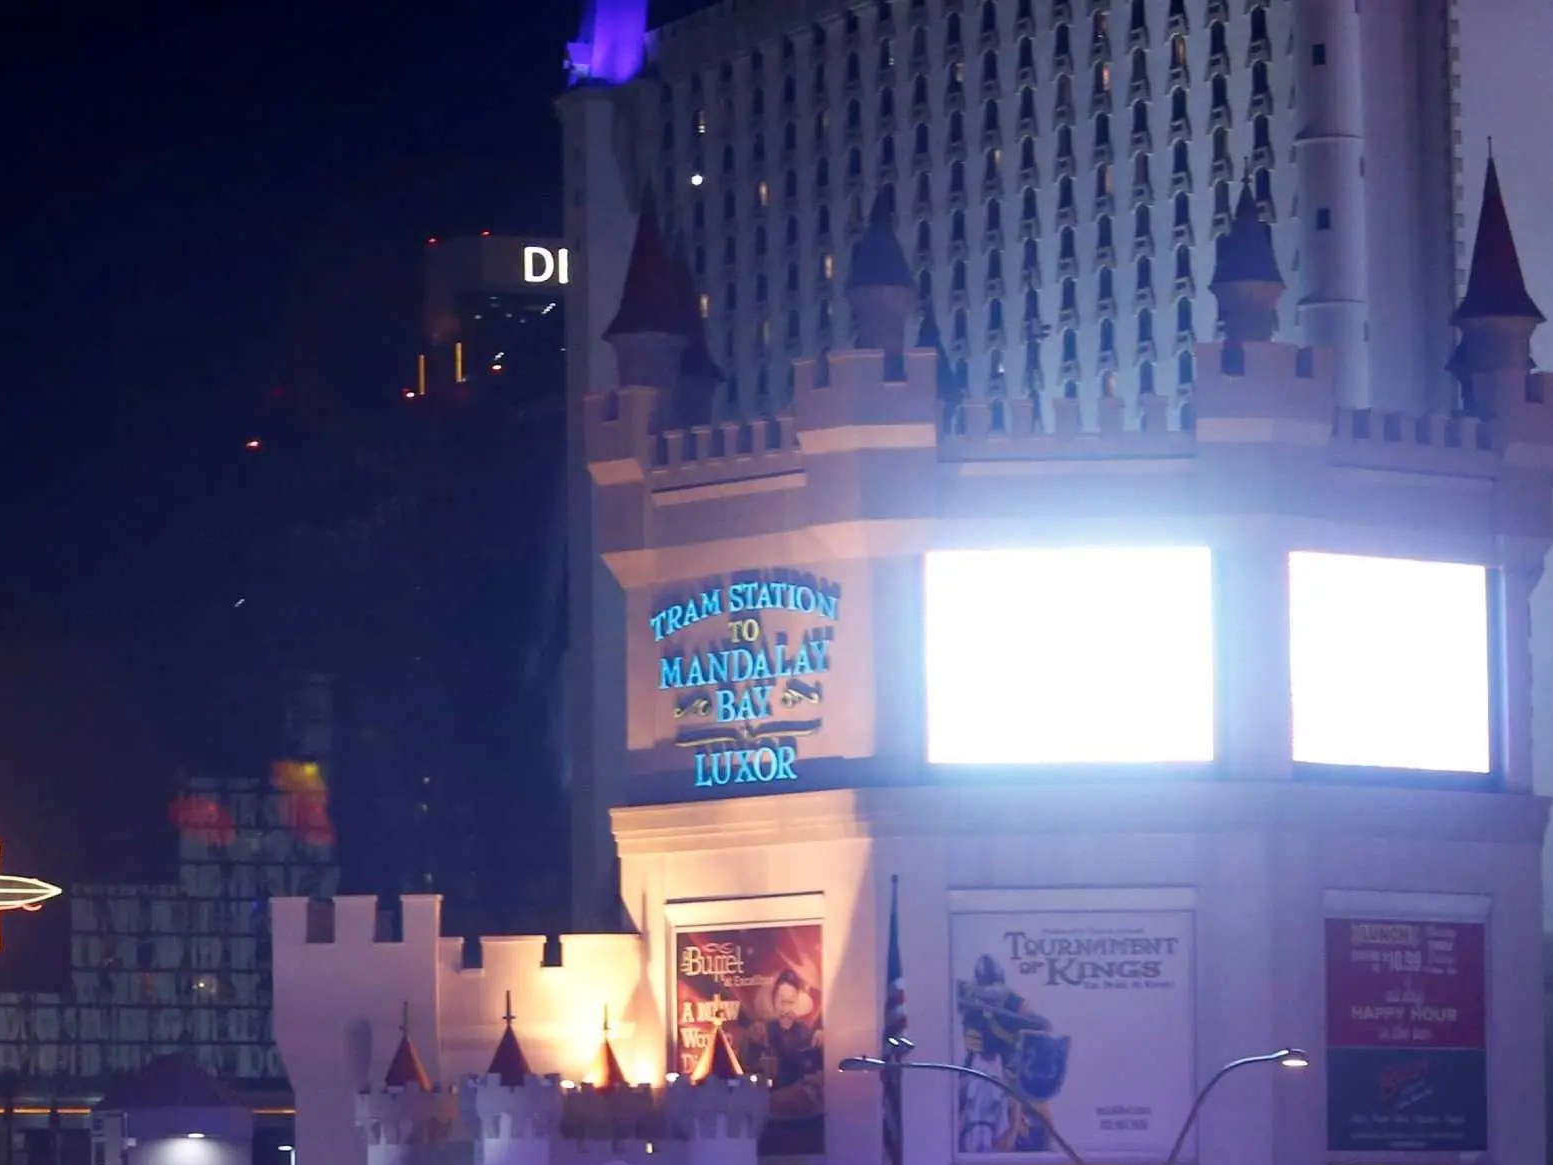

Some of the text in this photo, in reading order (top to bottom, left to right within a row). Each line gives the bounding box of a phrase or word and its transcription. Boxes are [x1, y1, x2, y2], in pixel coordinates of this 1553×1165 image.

[650, 582, 839, 641] TRAM STATION
[728, 618, 760, 643] TO
[658, 639, 832, 690] MANDALAY
[716, 685, 774, 723] BAY
[694, 746, 798, 787] LUXOR
[1046, 957, 1164, 986] KINGS
